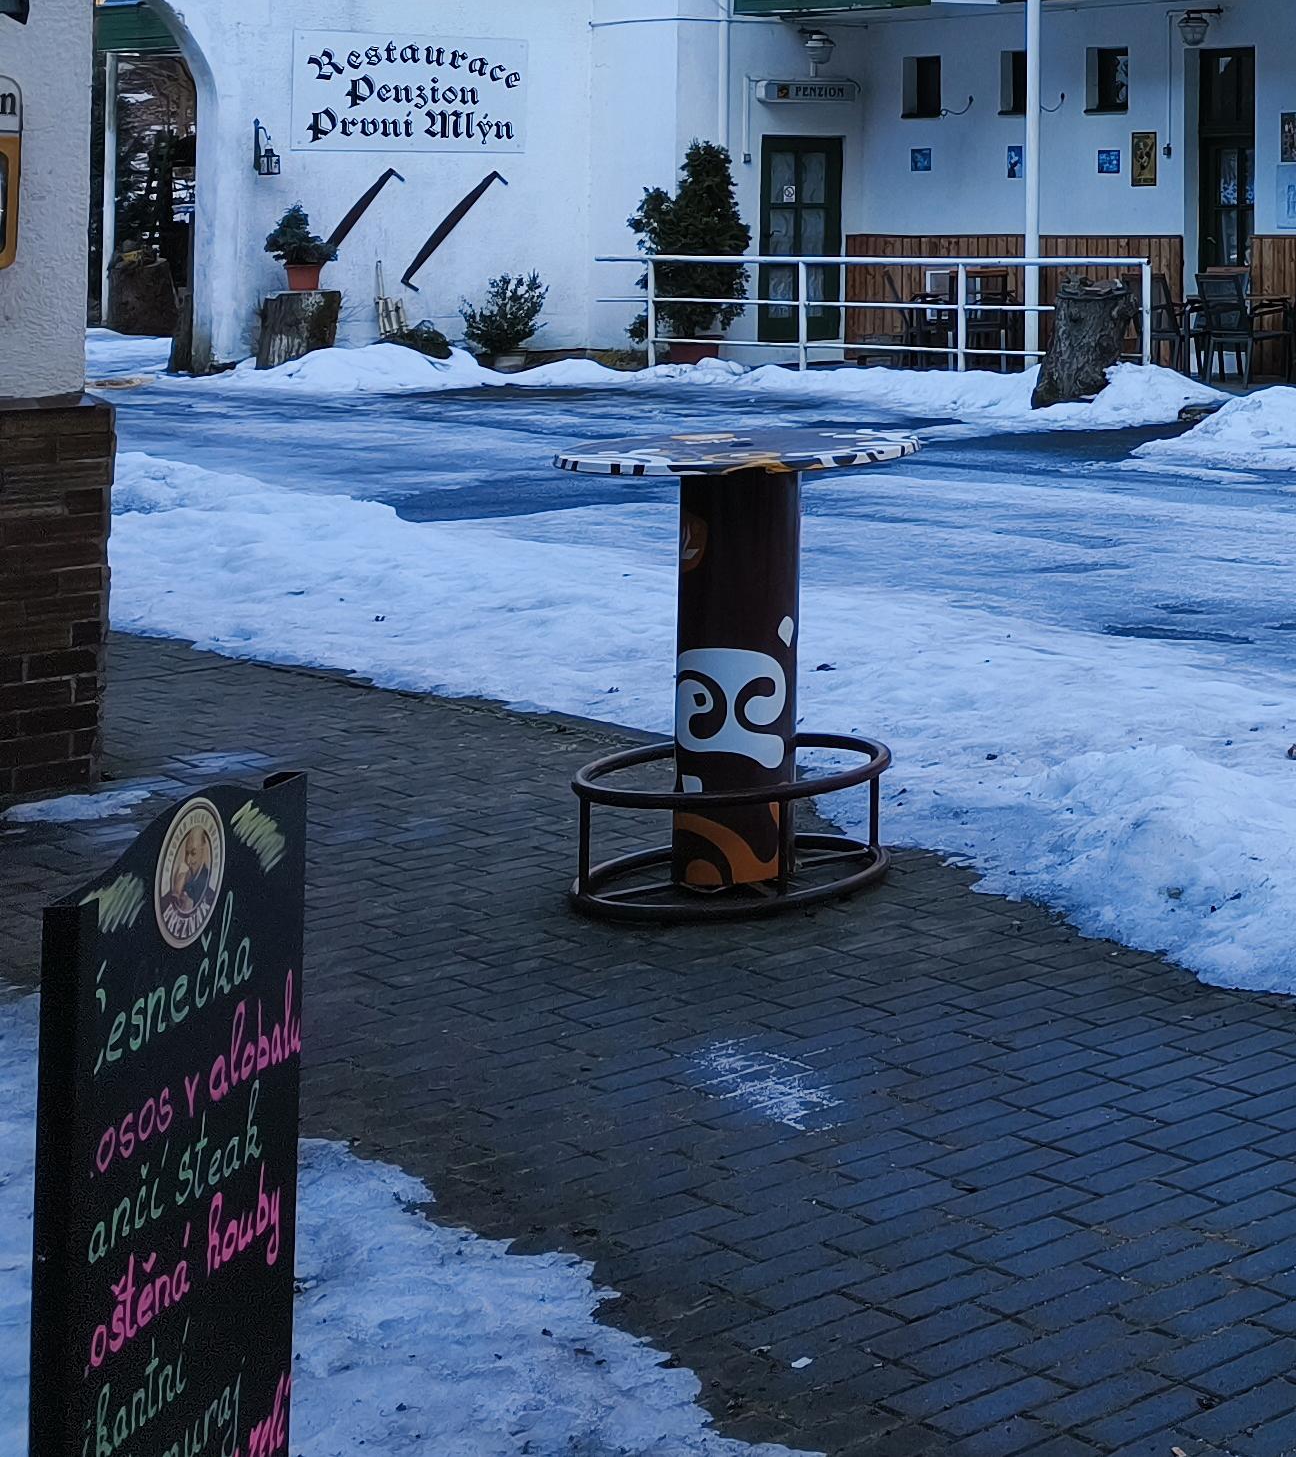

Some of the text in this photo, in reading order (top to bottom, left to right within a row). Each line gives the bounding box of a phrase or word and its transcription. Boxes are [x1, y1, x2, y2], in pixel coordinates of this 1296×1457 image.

[307, 40, 521, 89] Restaurace
[345, 73, 480, 110] Penzion
[795, 86, 845, 98] PENZION
[306, 106, 515, 144] První Mlýn
[93, 1085, 174, 1176] osos
[87, 1140, 169, 1265] ančí
[85, 1221, 191, 1378] oštěná
